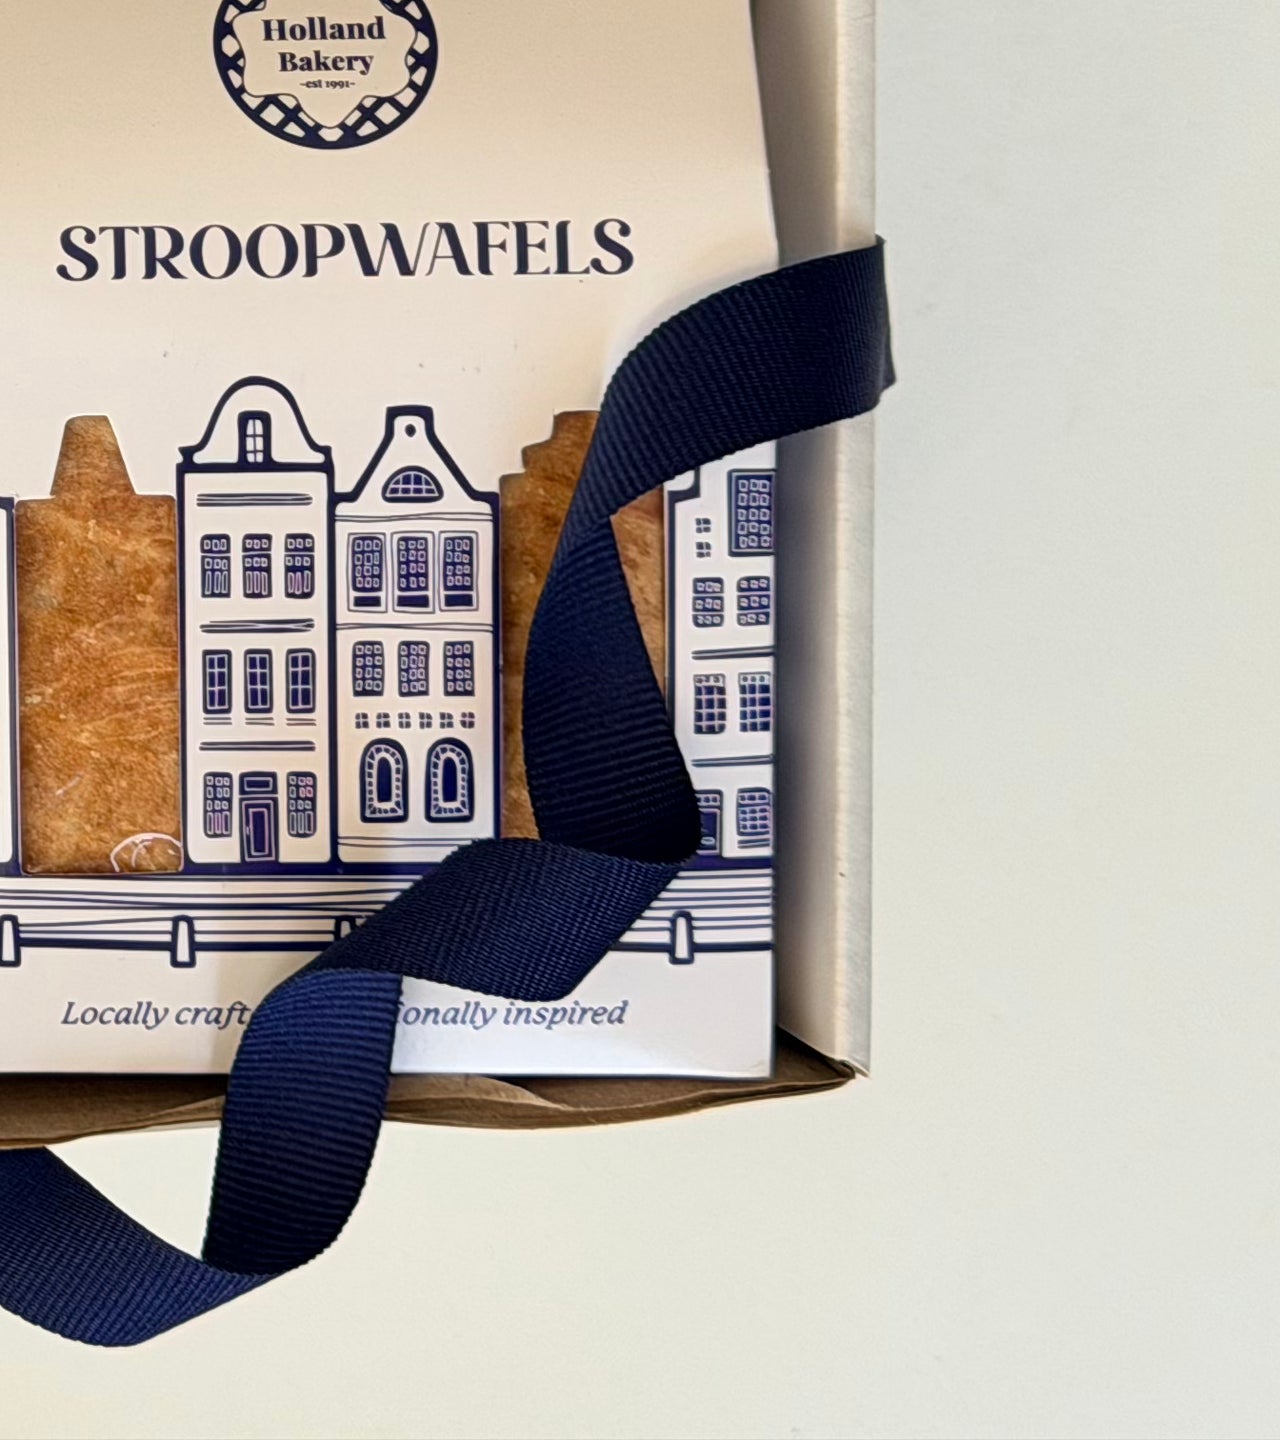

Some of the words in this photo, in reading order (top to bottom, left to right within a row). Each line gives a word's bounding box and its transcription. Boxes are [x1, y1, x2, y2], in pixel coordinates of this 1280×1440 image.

[261, 16, 386, 41] Holland
[278, 50, 374, 76] Bakery
[56, 219, 634, 282] STROOPWAFELS
[61, 1000, 170, 1031] Locally
[174, 1000, 252, 1031] craft
[397, 1001, 498, 1031] onally
[502, 1000, 630, 1031] inspired
